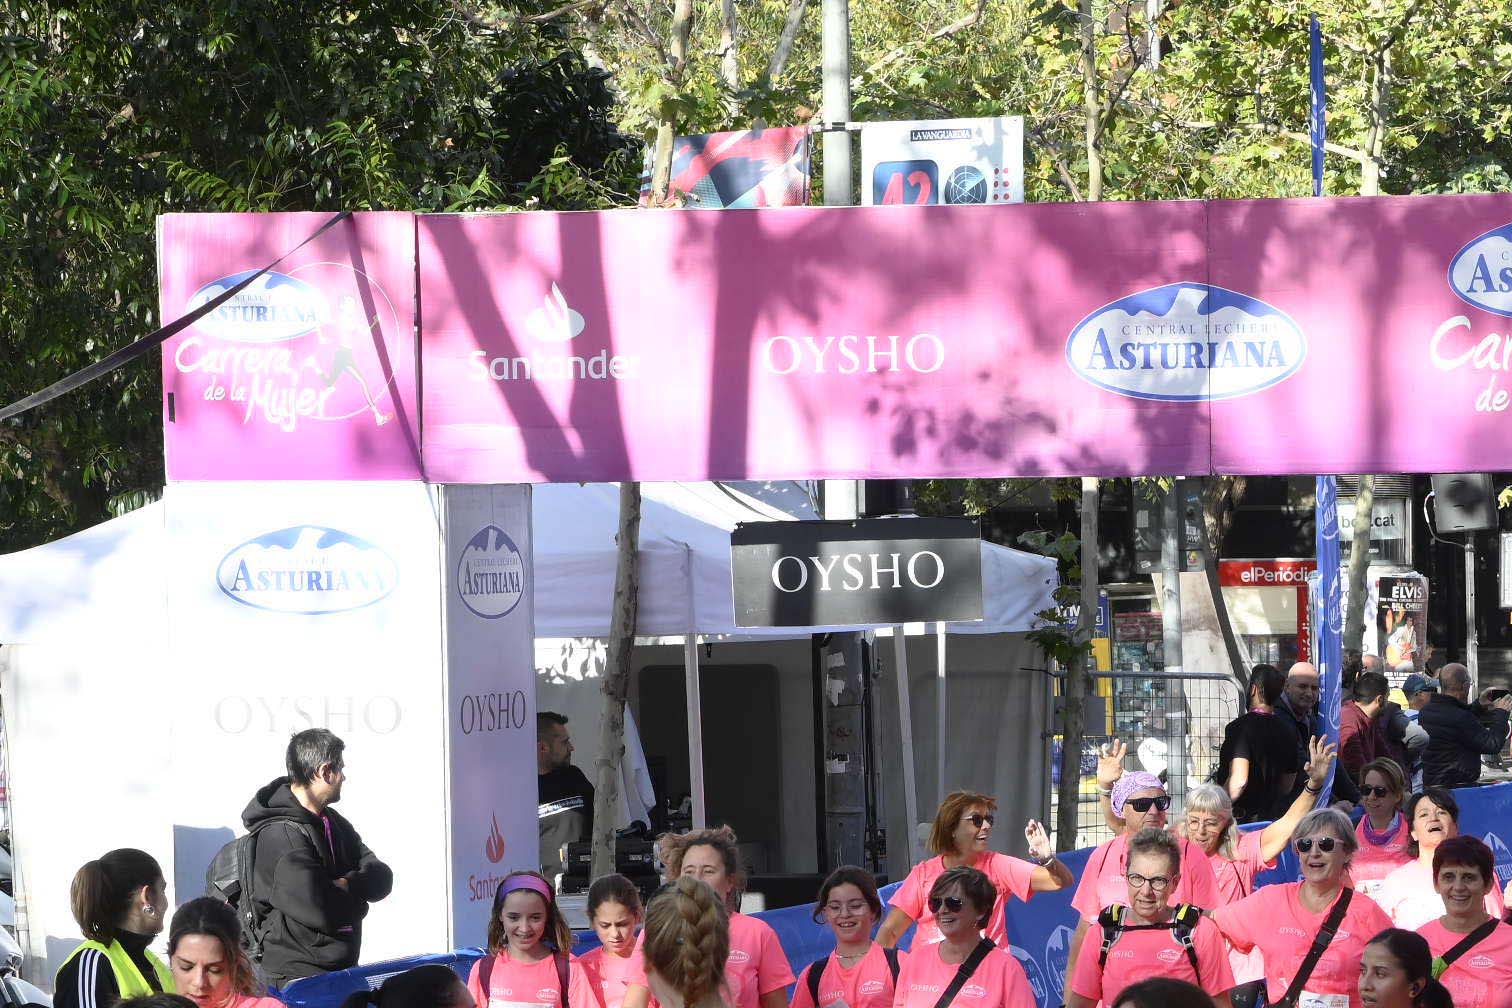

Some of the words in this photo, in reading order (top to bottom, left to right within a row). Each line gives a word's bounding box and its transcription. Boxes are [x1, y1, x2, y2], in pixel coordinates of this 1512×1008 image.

[1084, 326, 1287, 371] ASTURIANA
[1121, 323, 1197, 336] CENTRAL
[175, 336, 292, 373] Carrera
[470, 349, 642, 380] Santander
[763, 332, 945, 375] OYSHO
[204, 374, 226, 400] de
[229, 374, 246, 401] la
[244, 370, 336, 432] Mujer
[1475, 374, 1511, 413] de
[463, 560, 520, 595] ASTURIANA
[771, 550, 945, 593] OYSHO
[1392, 586, 1422, 599] ELVIS
[214, 695, 402, 734] OYSHO
[461, 690, 526, 735] OYSHO
